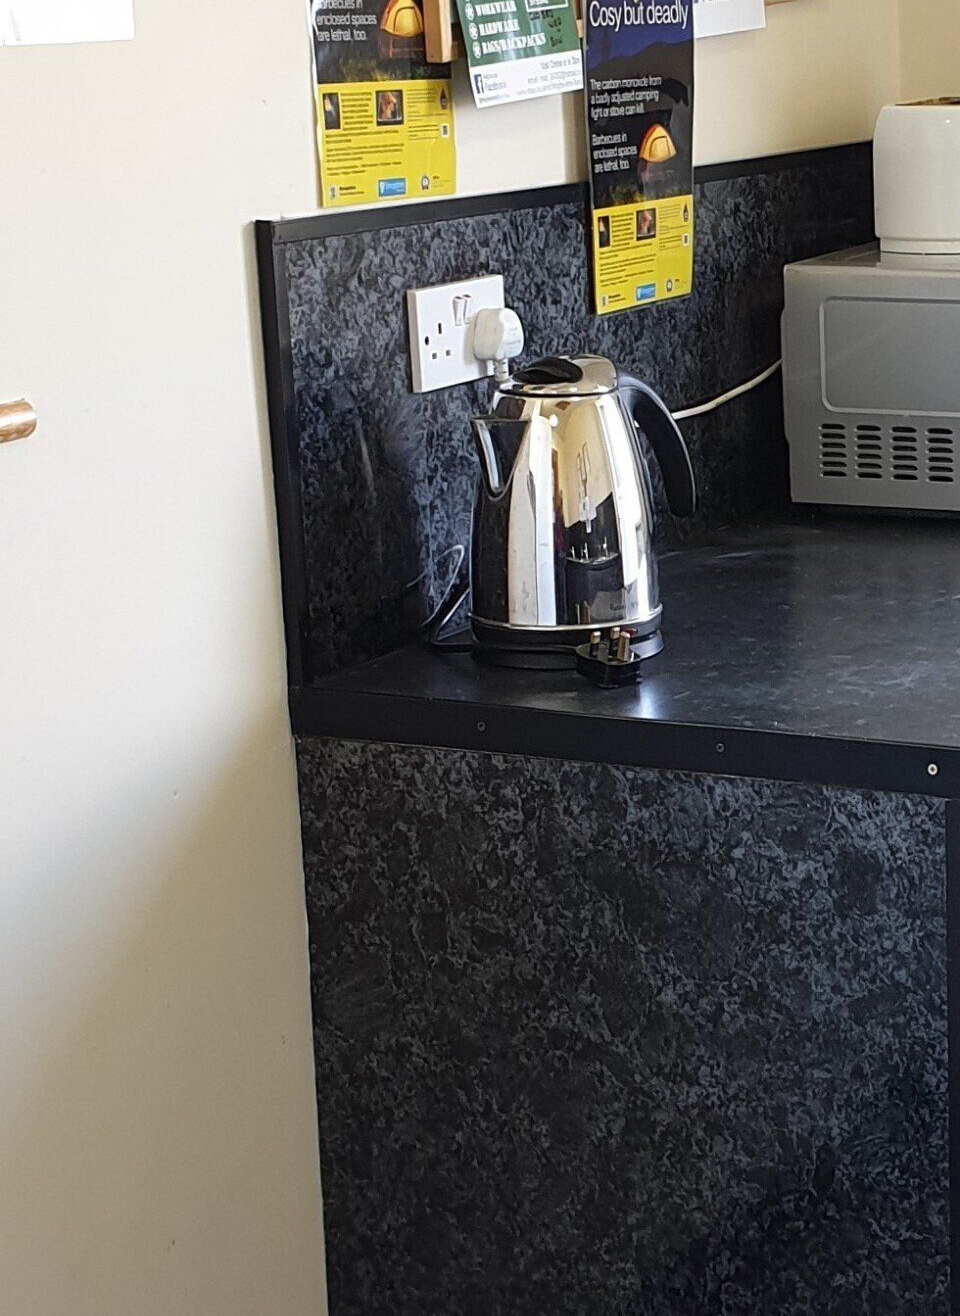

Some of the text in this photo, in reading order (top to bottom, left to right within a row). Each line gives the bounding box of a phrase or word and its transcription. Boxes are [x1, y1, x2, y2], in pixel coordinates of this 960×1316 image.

[474, 0, 517, 16] WORKWEAR
[316, 12, 377, 27] enclosed spaces
[589, 0, 689, 32] Cosy but deadly
[478, 19, 520, 36] HARDWARE
[317, 31, 330, 42] are
[481, 32, 547, 55] BAGS/BACKPACKS
[590, 75, 662, 90] The carbon monoxide from
[595, 93, 611, 105] badly
[611, 90, 635, 104] adjusted
[635, 90, 659, 102] camping
[591, 107, 603, 121] light
[603, 108, 609, 117] or
[609, 105, 625, 117] stove
[625, 105, 636, 116] can
[592, 132, 627, 146] Barbecues in
[593, 145, 638, 160] enclosed spaces
[594, 162, 603, 173] are
